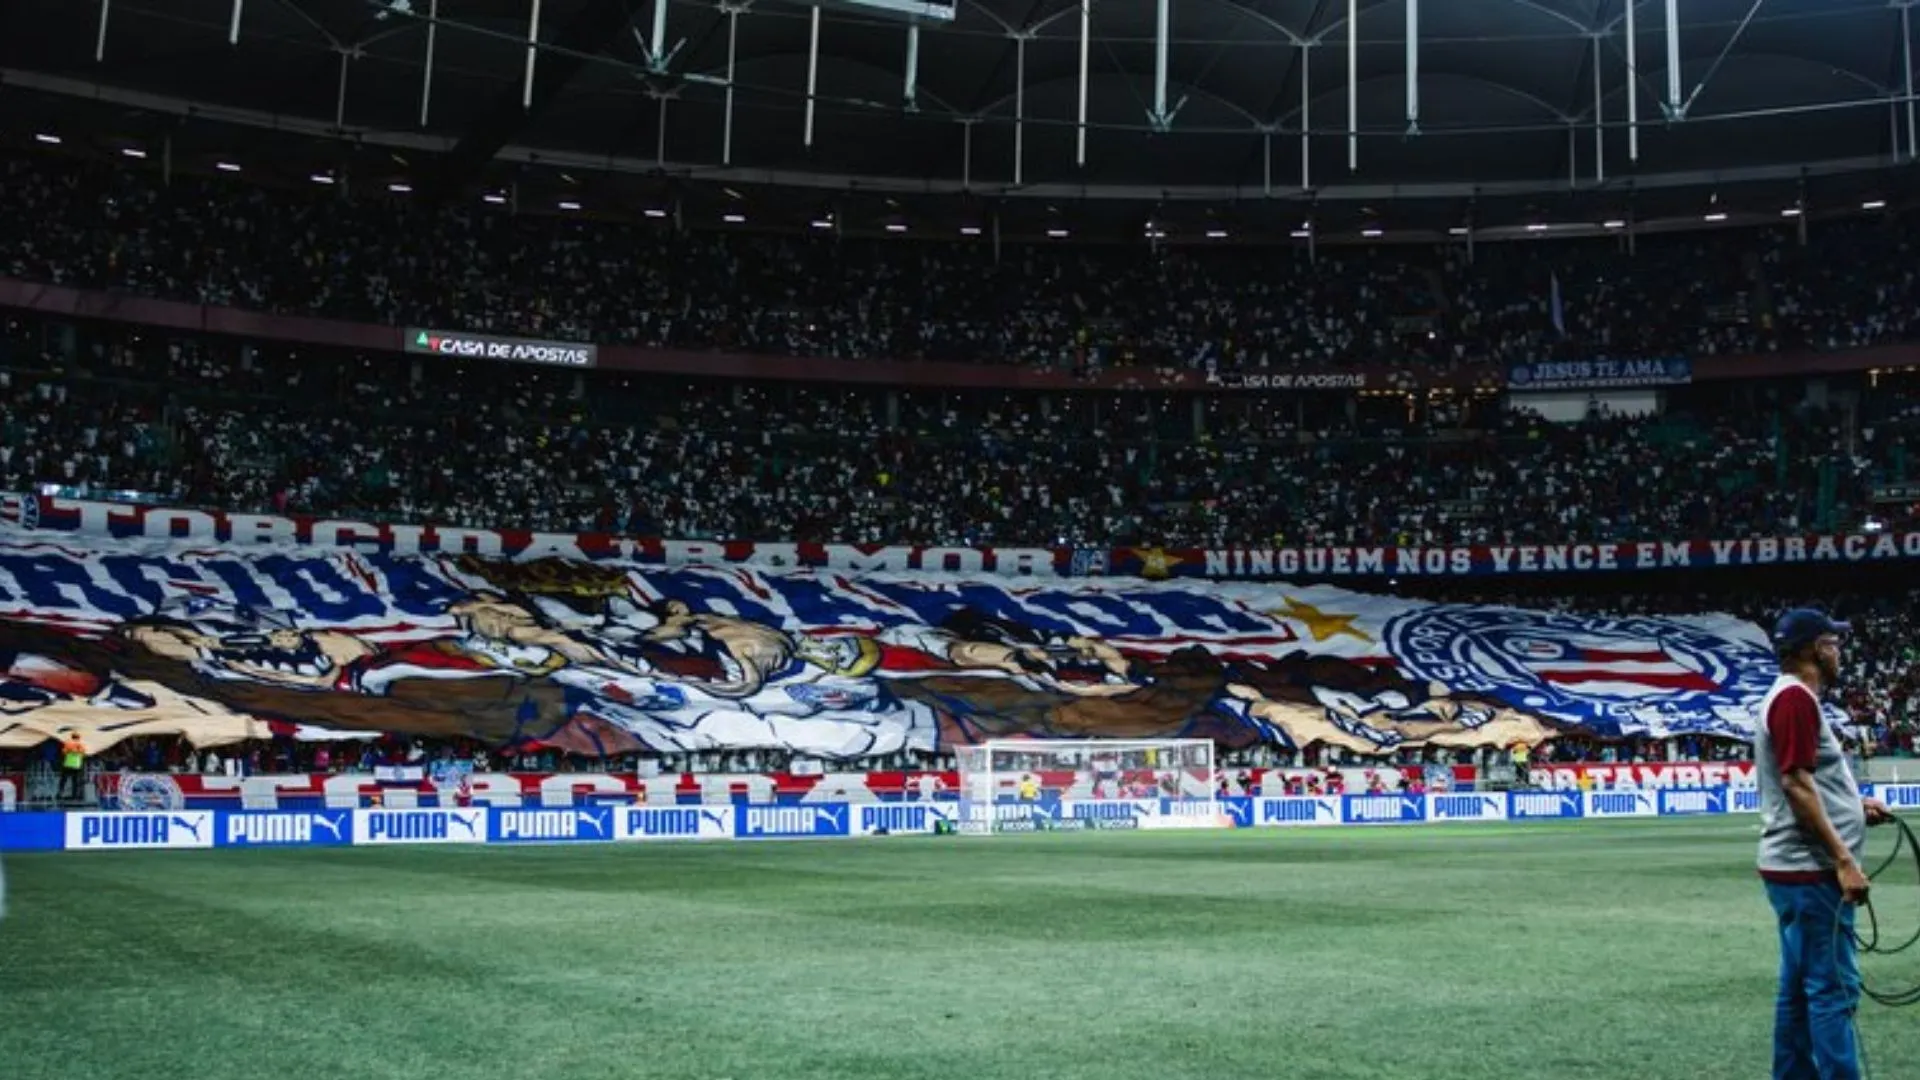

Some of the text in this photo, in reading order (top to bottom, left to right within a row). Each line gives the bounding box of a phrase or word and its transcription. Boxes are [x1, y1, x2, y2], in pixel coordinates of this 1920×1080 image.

[440, 339, 588, 364] CASA DE APOSTAS
[1272, 374, 1291, 387] DE
[1294, 374, 1365, 387] APOSTAS
[1533, 359, 1665, 379] JESUS TE AMA
[53, 499, 592, 562] TORCIDA
[1205, 547, 1385, 574] NINGUEM
[1396, 547, 1472, 574] NOS
[1490, 544, 1618, 571] VENCE
[1636, 541, 1692, 568] EM
[1264, 799, 1316, 820] PUMA
[1351, 798, 1401, 819] PUMA
[1435, 796, 1483, 817] PUMA
[1515, 793, 1562, 814] PUMA
[1592, 792, 1636, 813] PUMA
[1665, 792, 1707, 812] PUMA
[82, 816, 169, 843] PUMA
[228, 814, 311, 843] PUMA
[368, 812, 448, 839] PUMA
[501, 811, 577, 838] PUMA
[627, 809, 698, 835] PUMA
[746, 807, 815, 833] PUMA
[862, 806, 926, 830] PUMA
